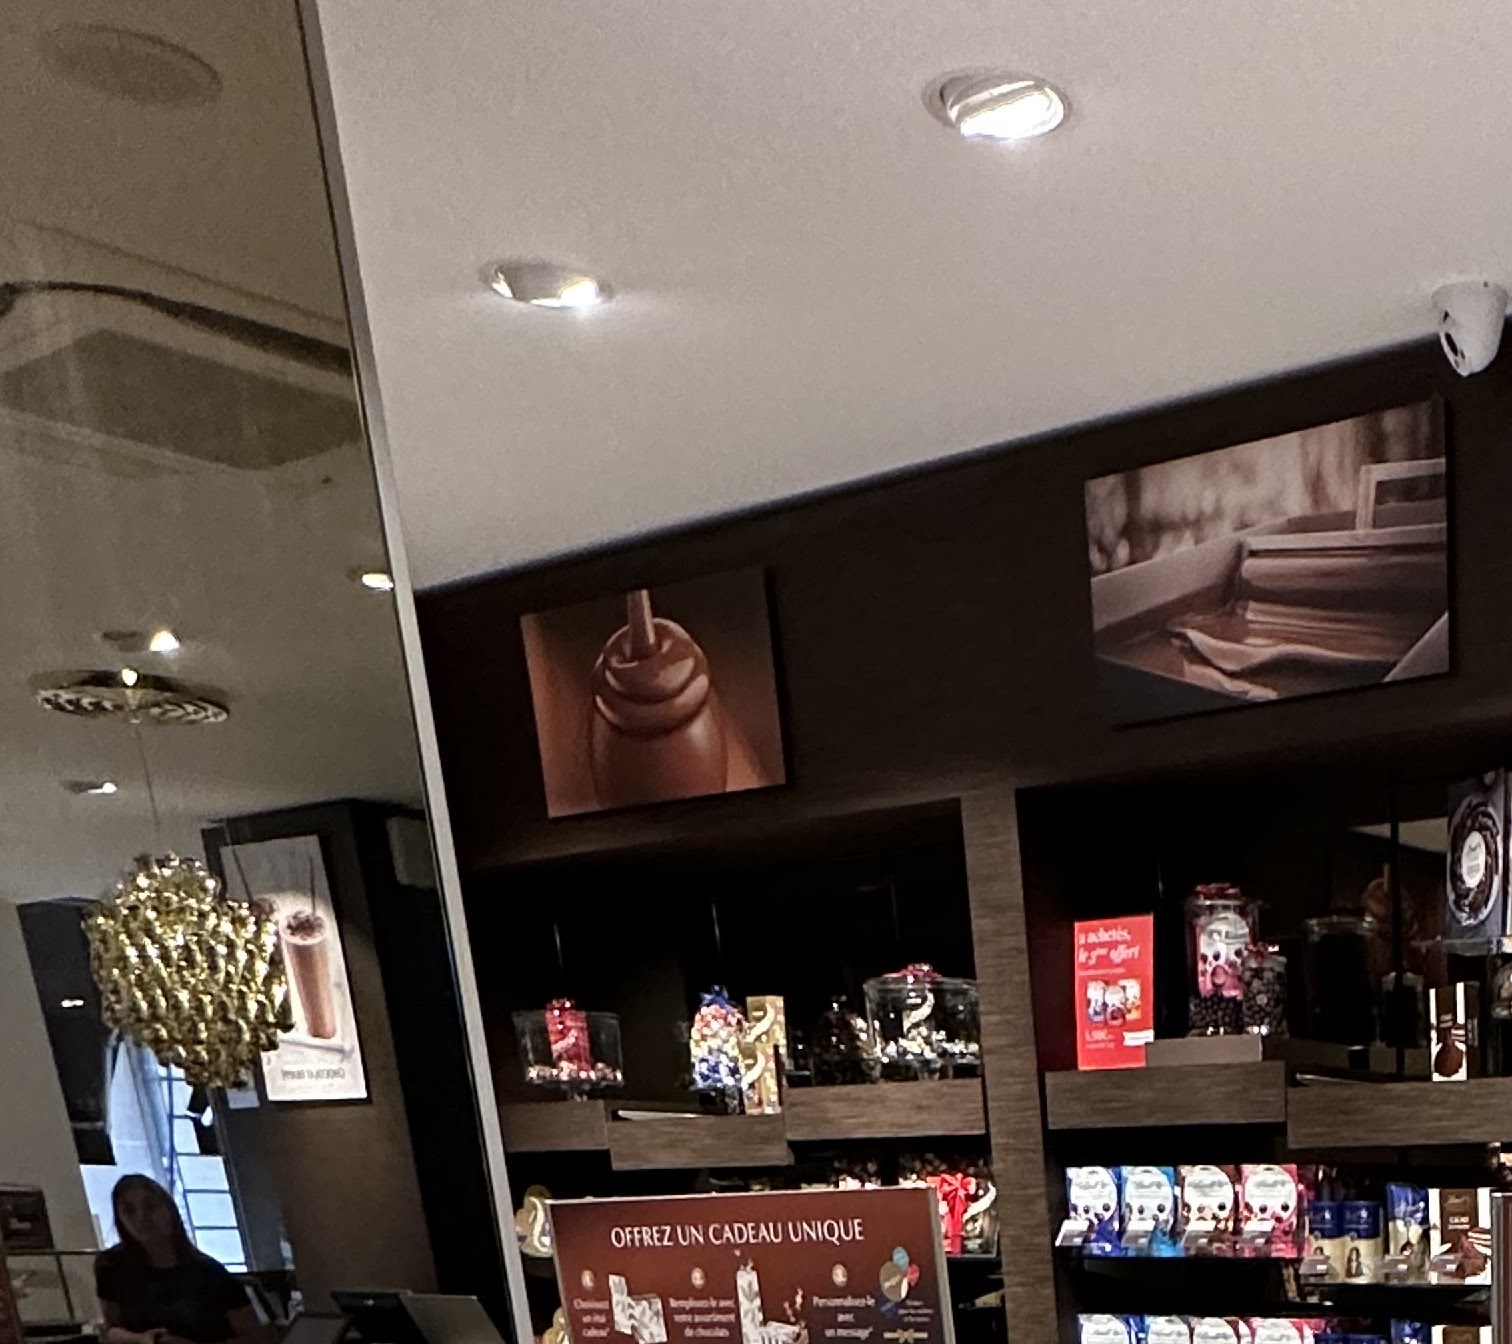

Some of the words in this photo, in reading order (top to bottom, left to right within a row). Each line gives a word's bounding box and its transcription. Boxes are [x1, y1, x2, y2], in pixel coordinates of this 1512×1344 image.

[611, 1225, 674, 1248] OFFREZ
[677, 1224, 704, 1246] UN
[708, 1221, 782, 1245] CADEAU
[788, 1218, 865, 1246] UNIQUE
